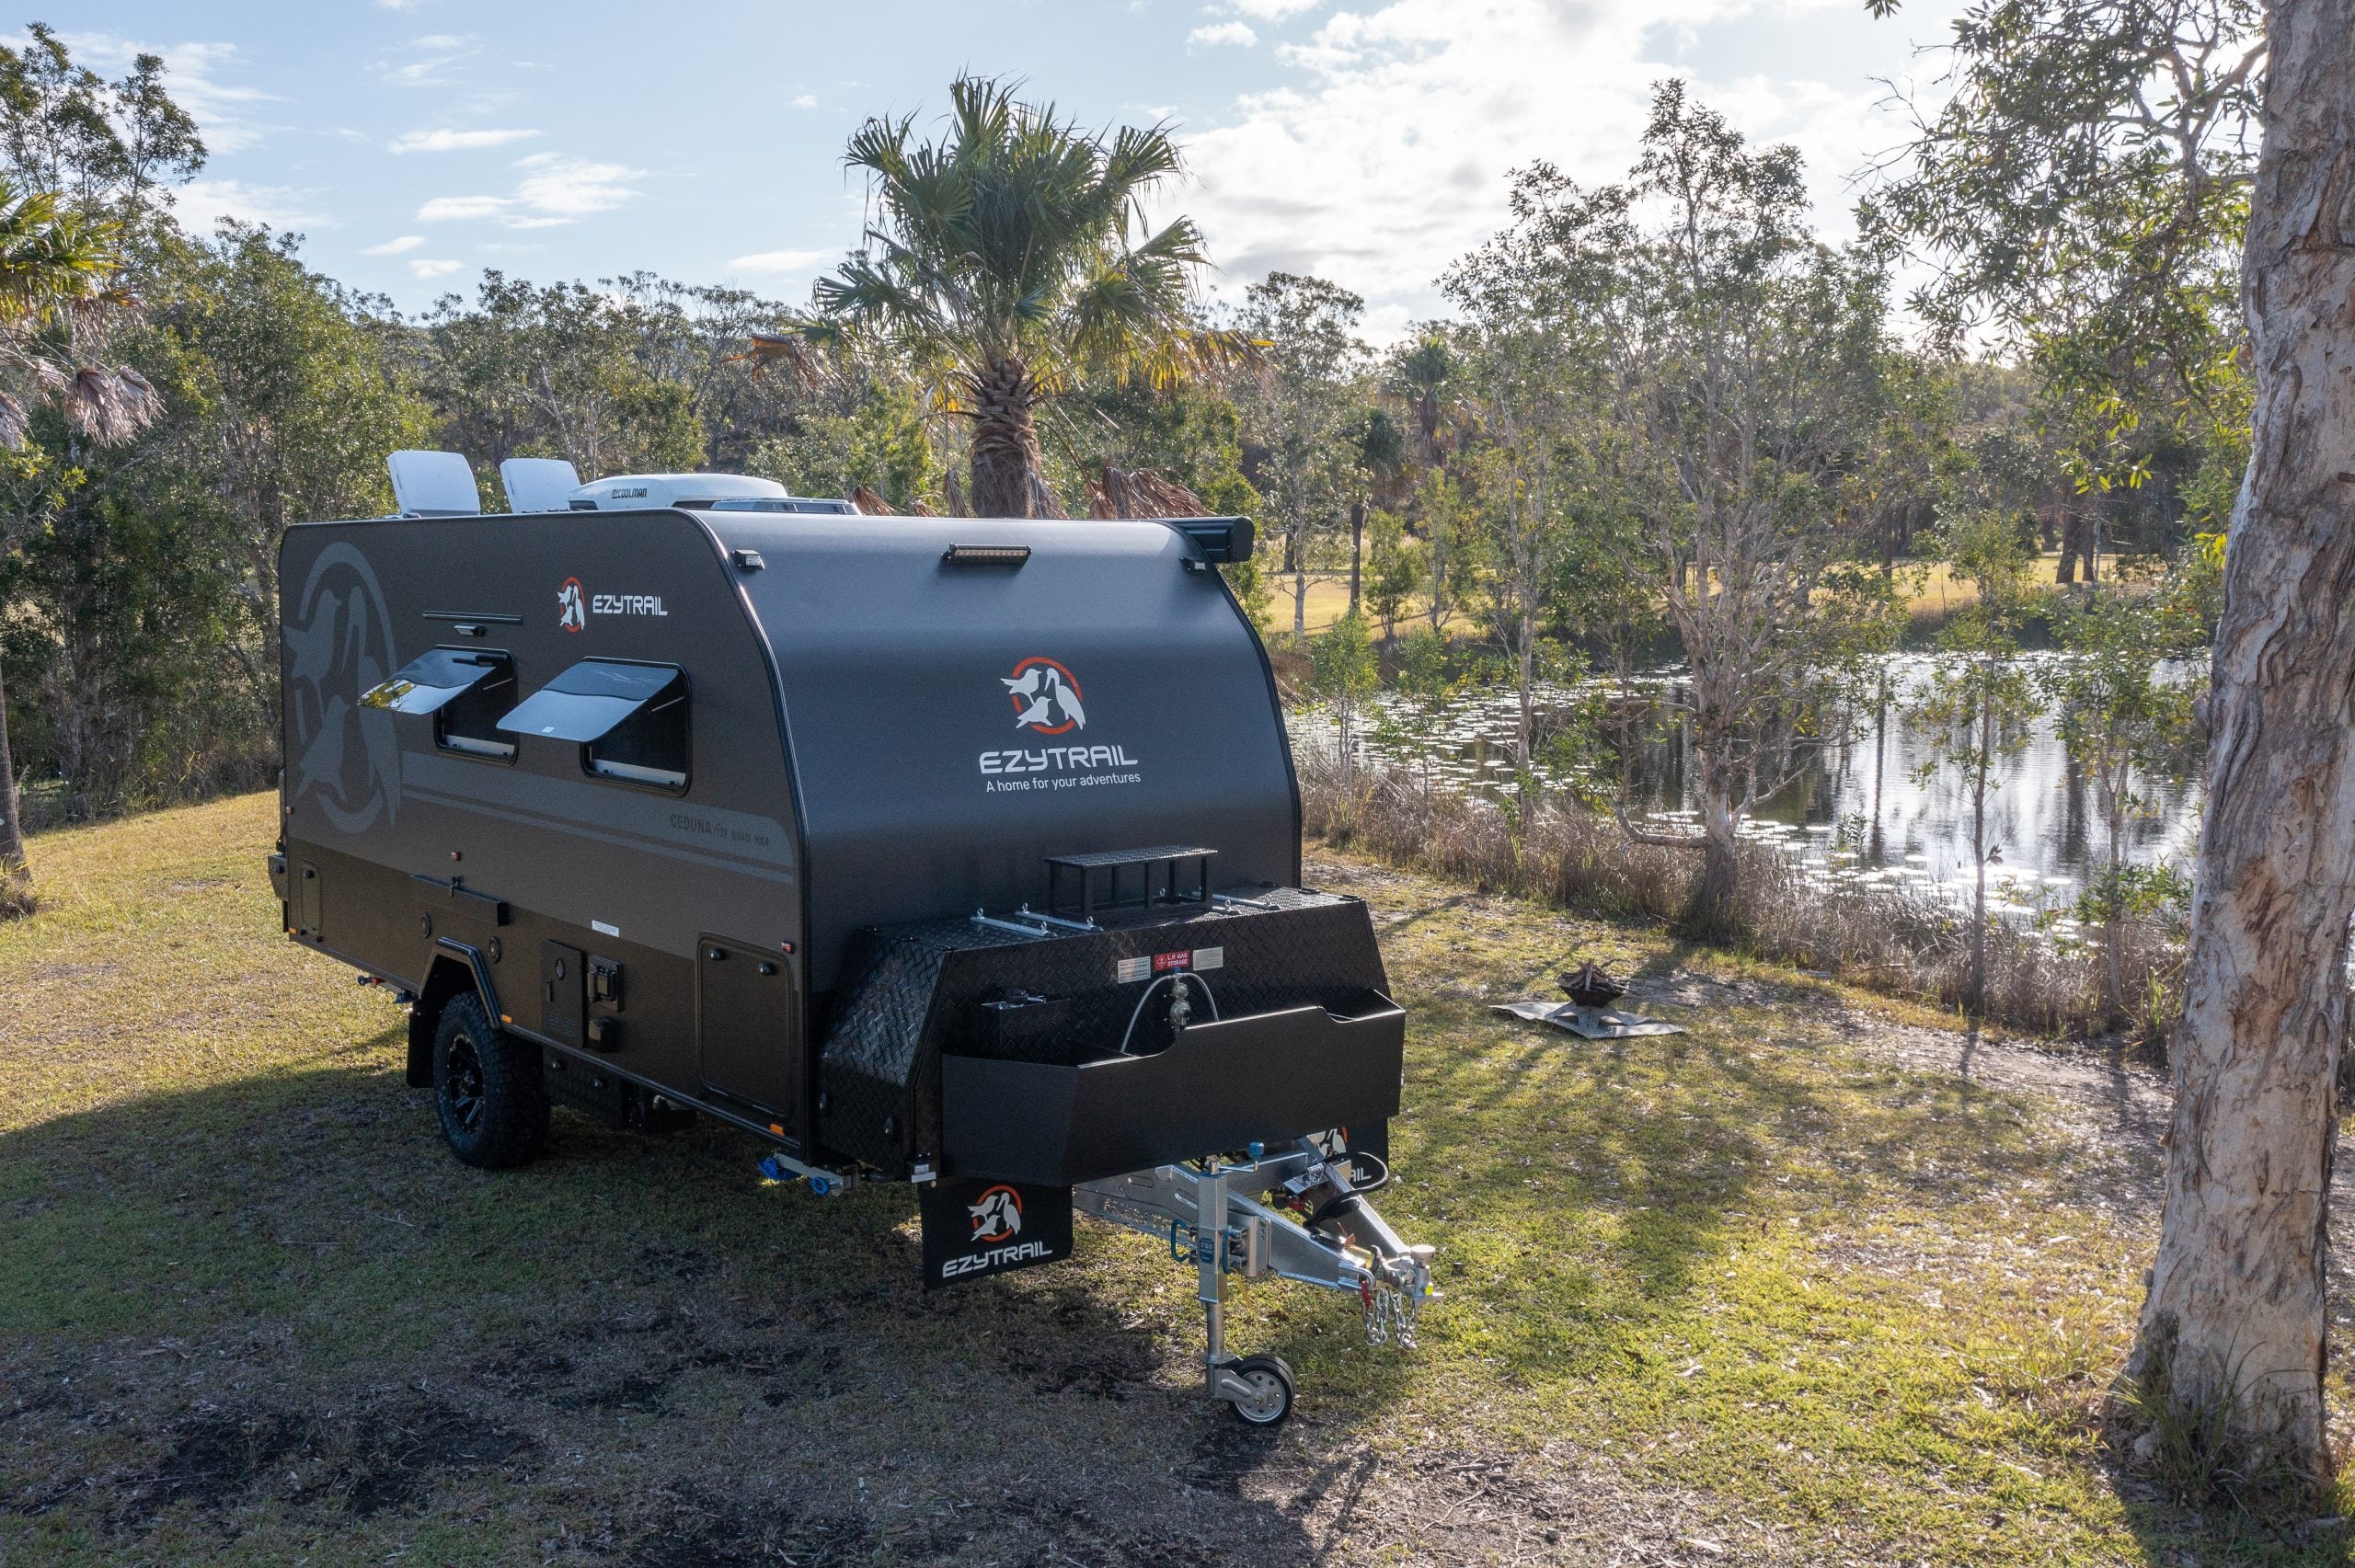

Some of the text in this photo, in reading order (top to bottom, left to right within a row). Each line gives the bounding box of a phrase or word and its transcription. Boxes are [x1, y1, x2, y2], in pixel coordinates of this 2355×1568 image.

[592, 594, 669, 616] EZYTRAIL
[979, 745, 1139, 774] EZYTRAIL
[986, 773, 1142, 792] A home for your adventures
[942, 1241, 1052, 1278] EZYTRAIL
